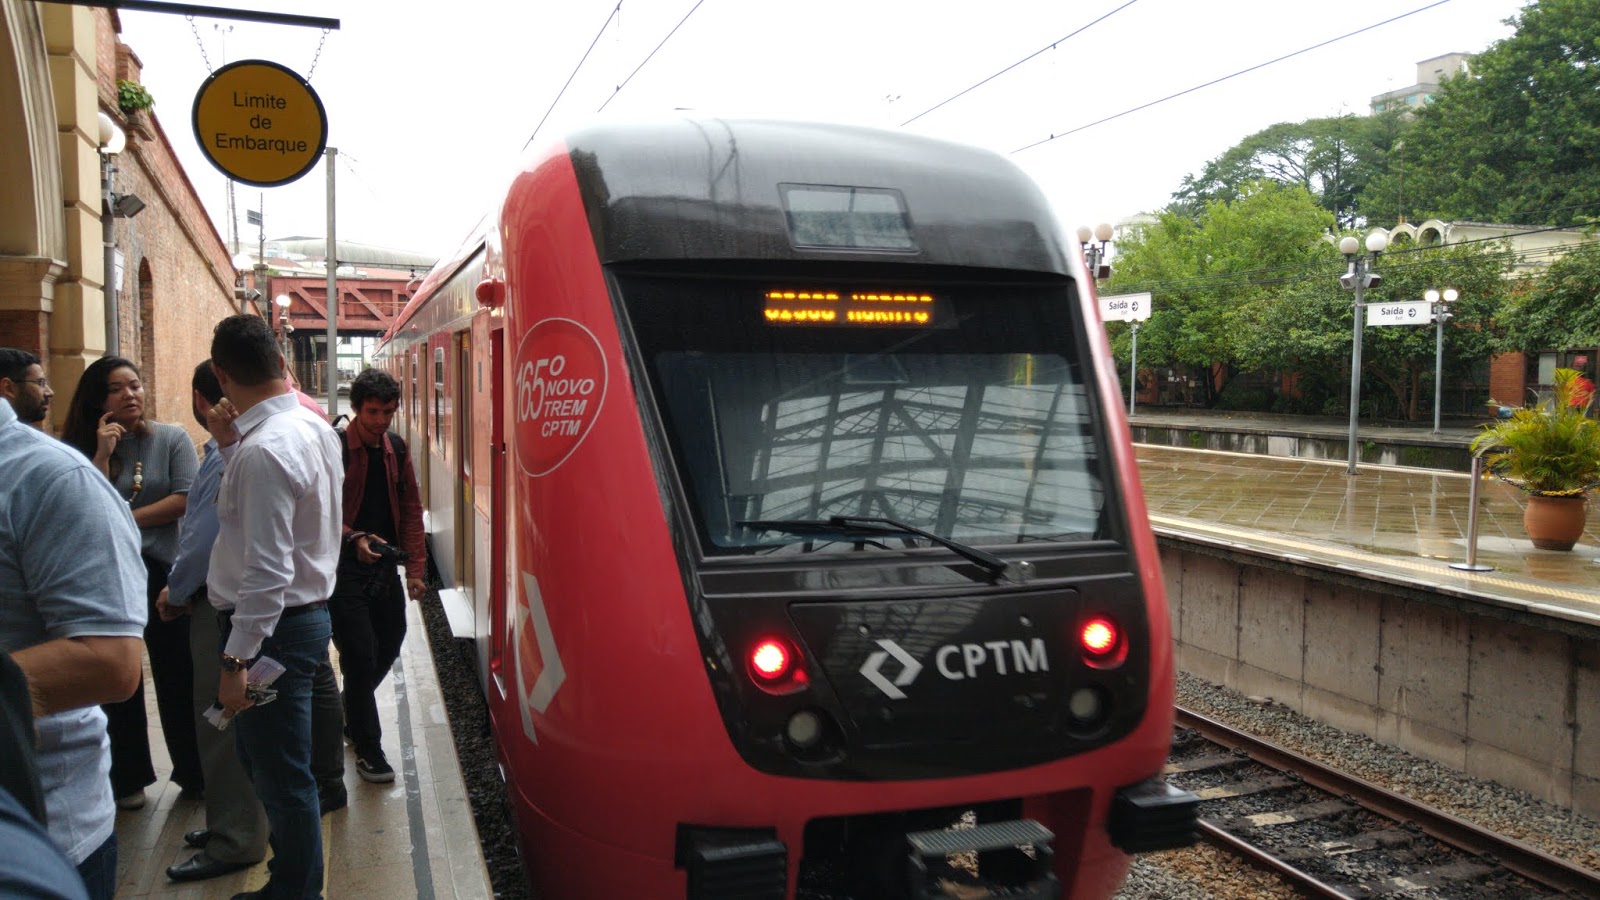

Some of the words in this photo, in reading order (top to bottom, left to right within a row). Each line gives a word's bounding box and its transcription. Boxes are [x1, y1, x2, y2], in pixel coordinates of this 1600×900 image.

[233, 91, 286, 109] Limite
[249, 114, 272, 129] de
[215, 133, 307, 155] Embarque
[1381, 307, 1404, 315] Saída
[545, 379, 595, 397] NOVO
[544, 399, 588, 417] TREM
[541, 420, 581, 437] CPTM
[936, 638, 1050, 680] CPTM
